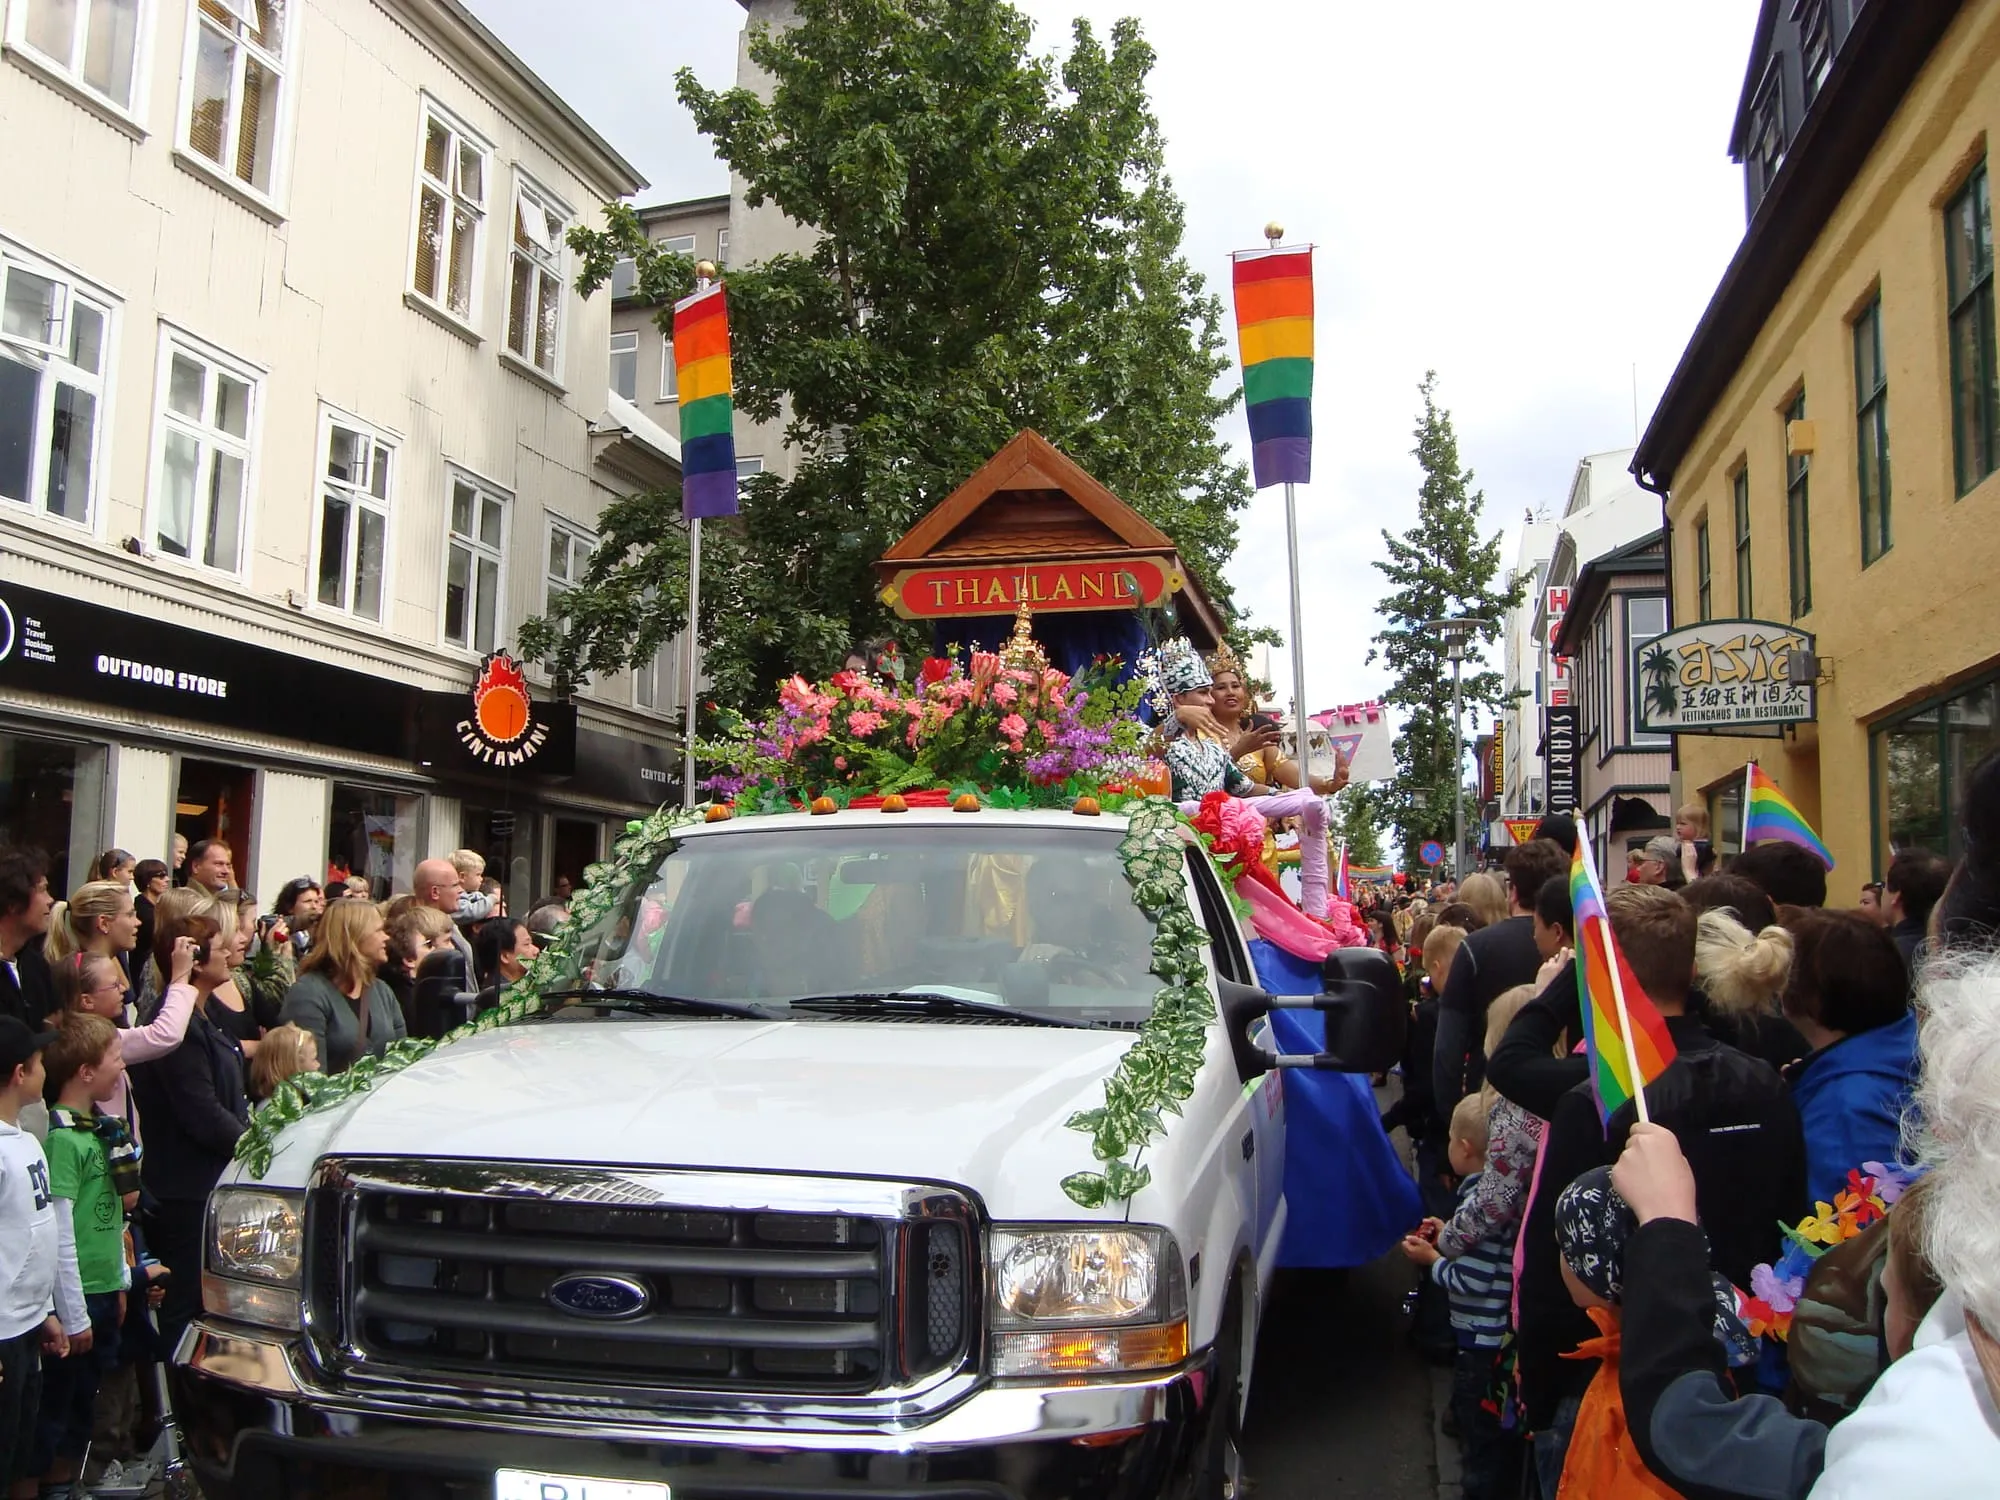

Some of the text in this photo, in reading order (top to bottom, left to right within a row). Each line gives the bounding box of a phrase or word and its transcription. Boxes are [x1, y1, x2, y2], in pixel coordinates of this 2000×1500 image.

[928, 571, 1135, 607] THAILAND
[26, 617, 41, 629] Free
[25, 628, 46, 640] Travel
[24, 638, 54, 653] Bookings
[30, 650, 56, 663] Internet
[97, 655, 227, 698] OUTDOOR STORE
[1735, 706, 1750, 719] BAR
[1754, 703, 1805, 718] RESTAURANT
[456, 719, 550, 767] CINTAMANI
[641, 768, 666, 783] CENTER
